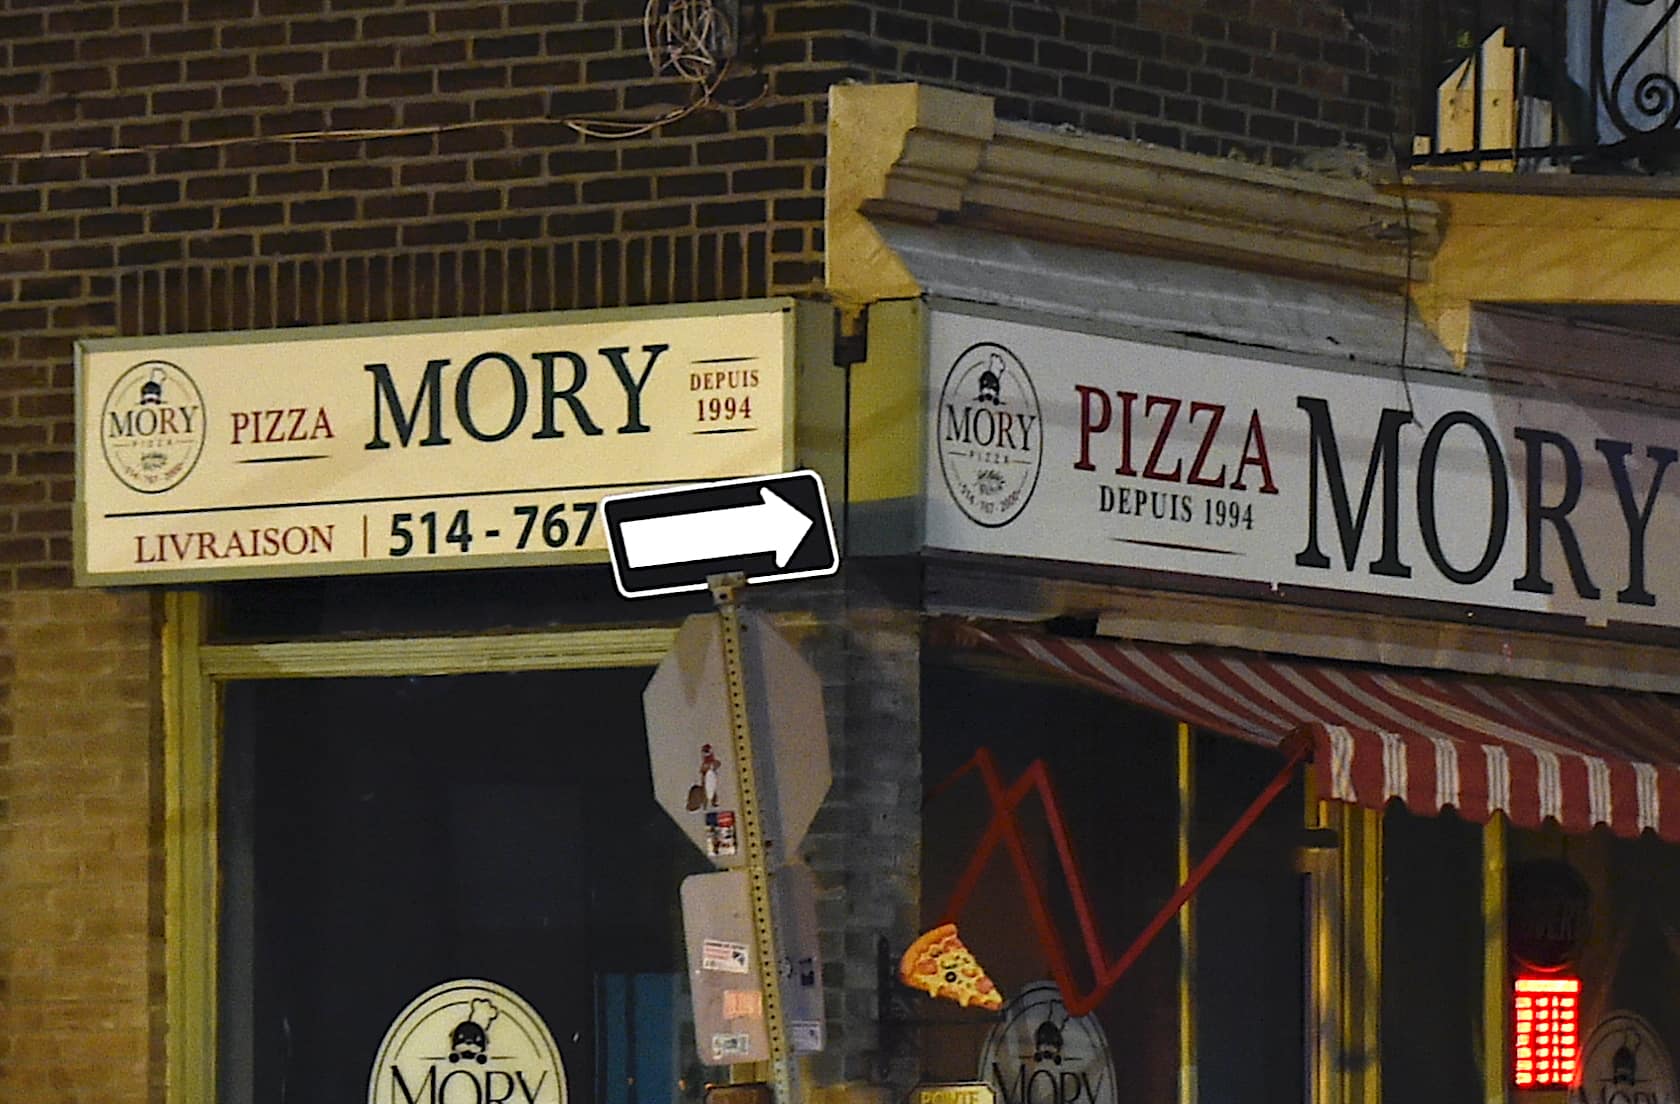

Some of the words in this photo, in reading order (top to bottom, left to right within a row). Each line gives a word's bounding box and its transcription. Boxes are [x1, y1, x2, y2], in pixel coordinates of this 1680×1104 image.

[364, 343, 670, 450] MORY
[690, 369, 760, 391] DEPUIS
[108, 405, 198, 438] MORY
[230, 406, 336, 445] PIZZA
[697, 395, 752, 422] 1994
[946, 404, 1036, 451] MORY
[1074, 384, 1279, 495] PIZZA
[1295, 395, 1679, 607] MORY
[1098, 484, 1193, 524] DEPUIS
[1204, 498, 1255, 530] 1994
[134, 524, 336, 564] LIVRAISON
